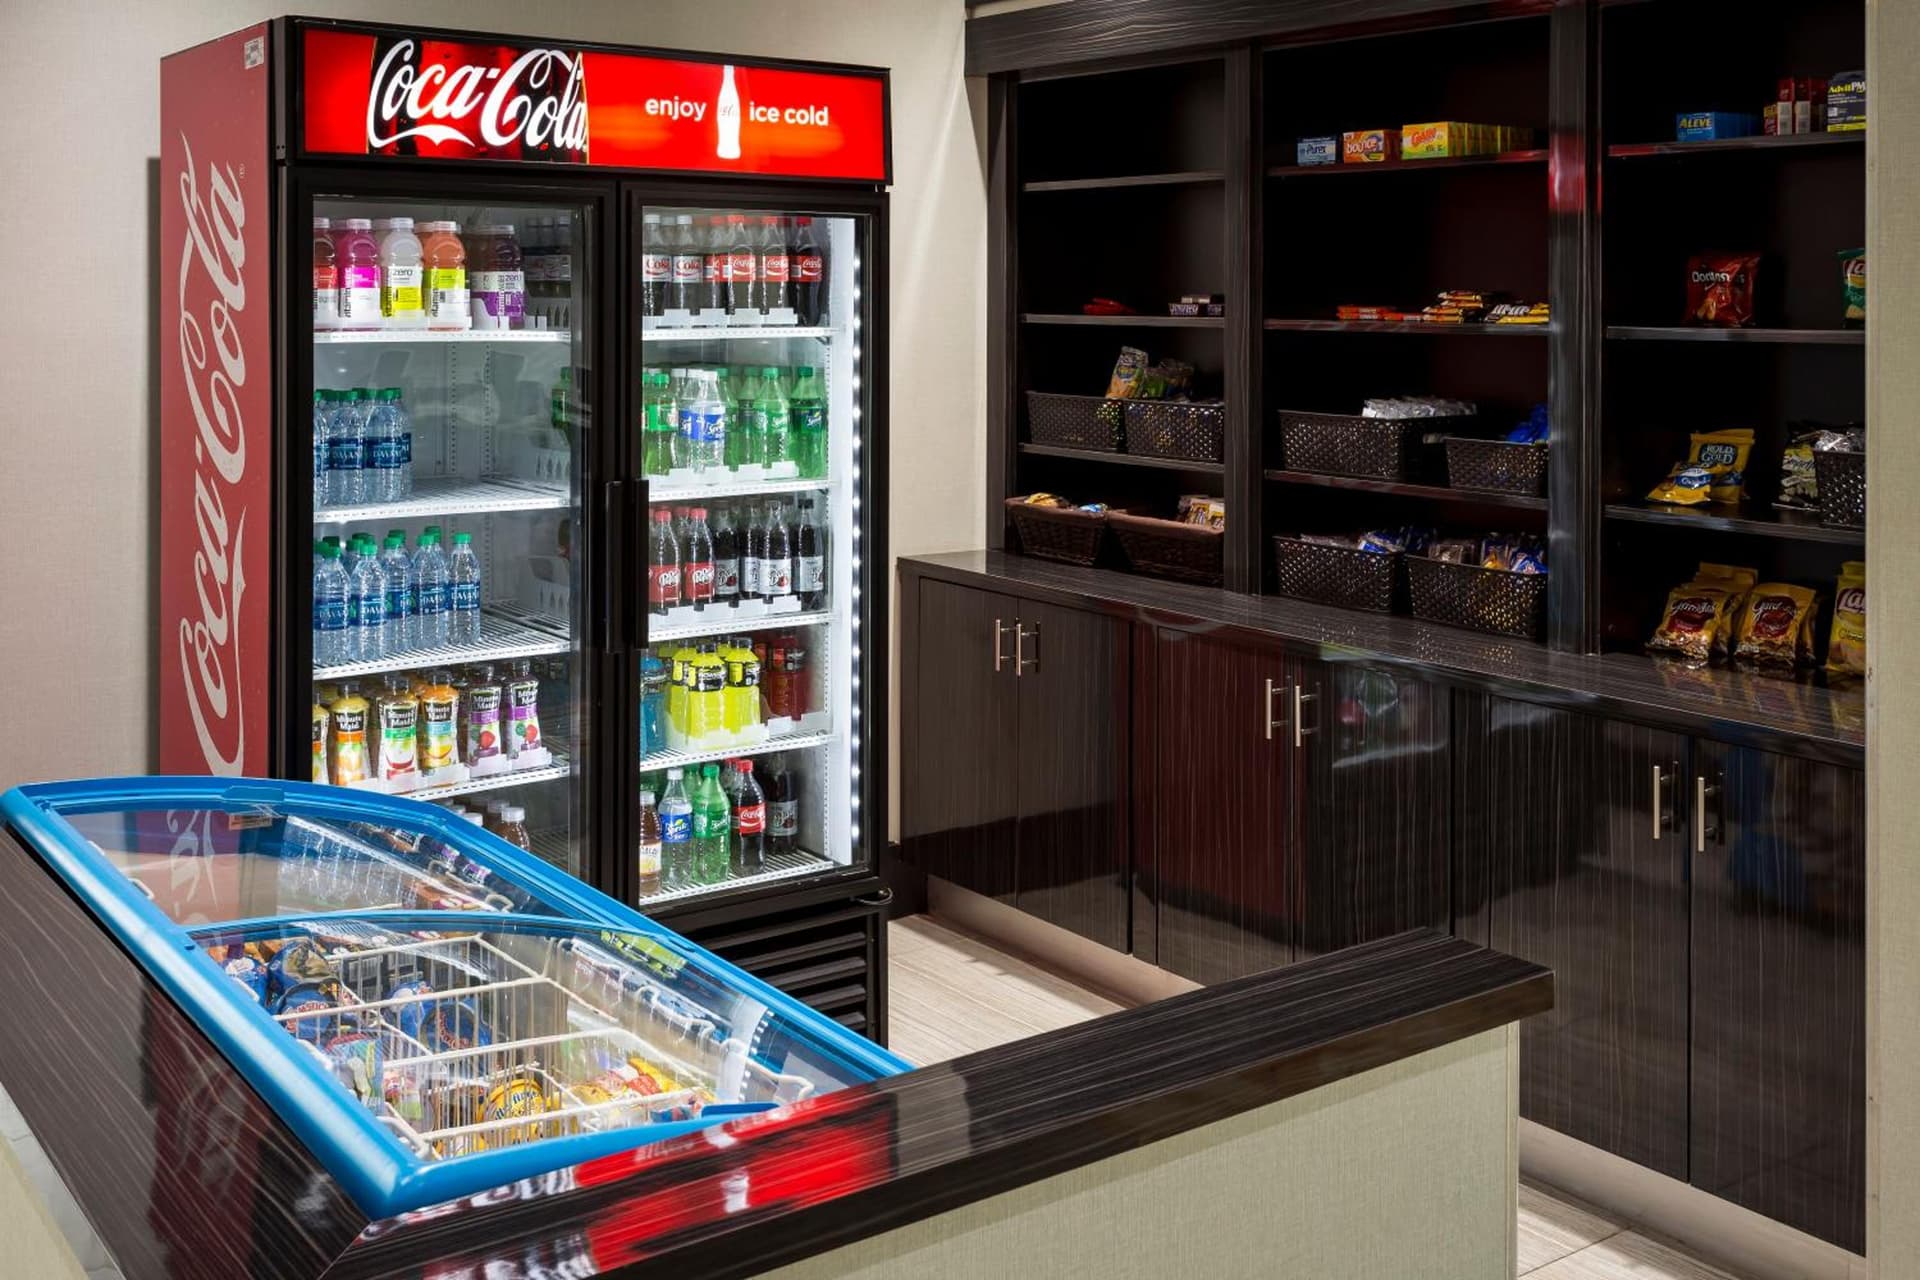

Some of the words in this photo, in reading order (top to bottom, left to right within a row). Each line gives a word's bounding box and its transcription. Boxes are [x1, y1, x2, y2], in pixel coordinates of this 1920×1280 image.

[1828, 82, 1851, 93] Advil
[368, 38, 588, 151] Coca-Cola
[646, 97, 706, 127] enjoy
[749, 103, 781, 124] ice
[784, 104, 828, 127] cold
[1679, 117, 1712, 129] ALEVE
[1692, 270, 1730, 283] Doritos
[180, 130, 246, 776] Coca-Cola
[1706, 444, 1735, 455] ROLD
[1700, 453, 1735, 465] GOLD
